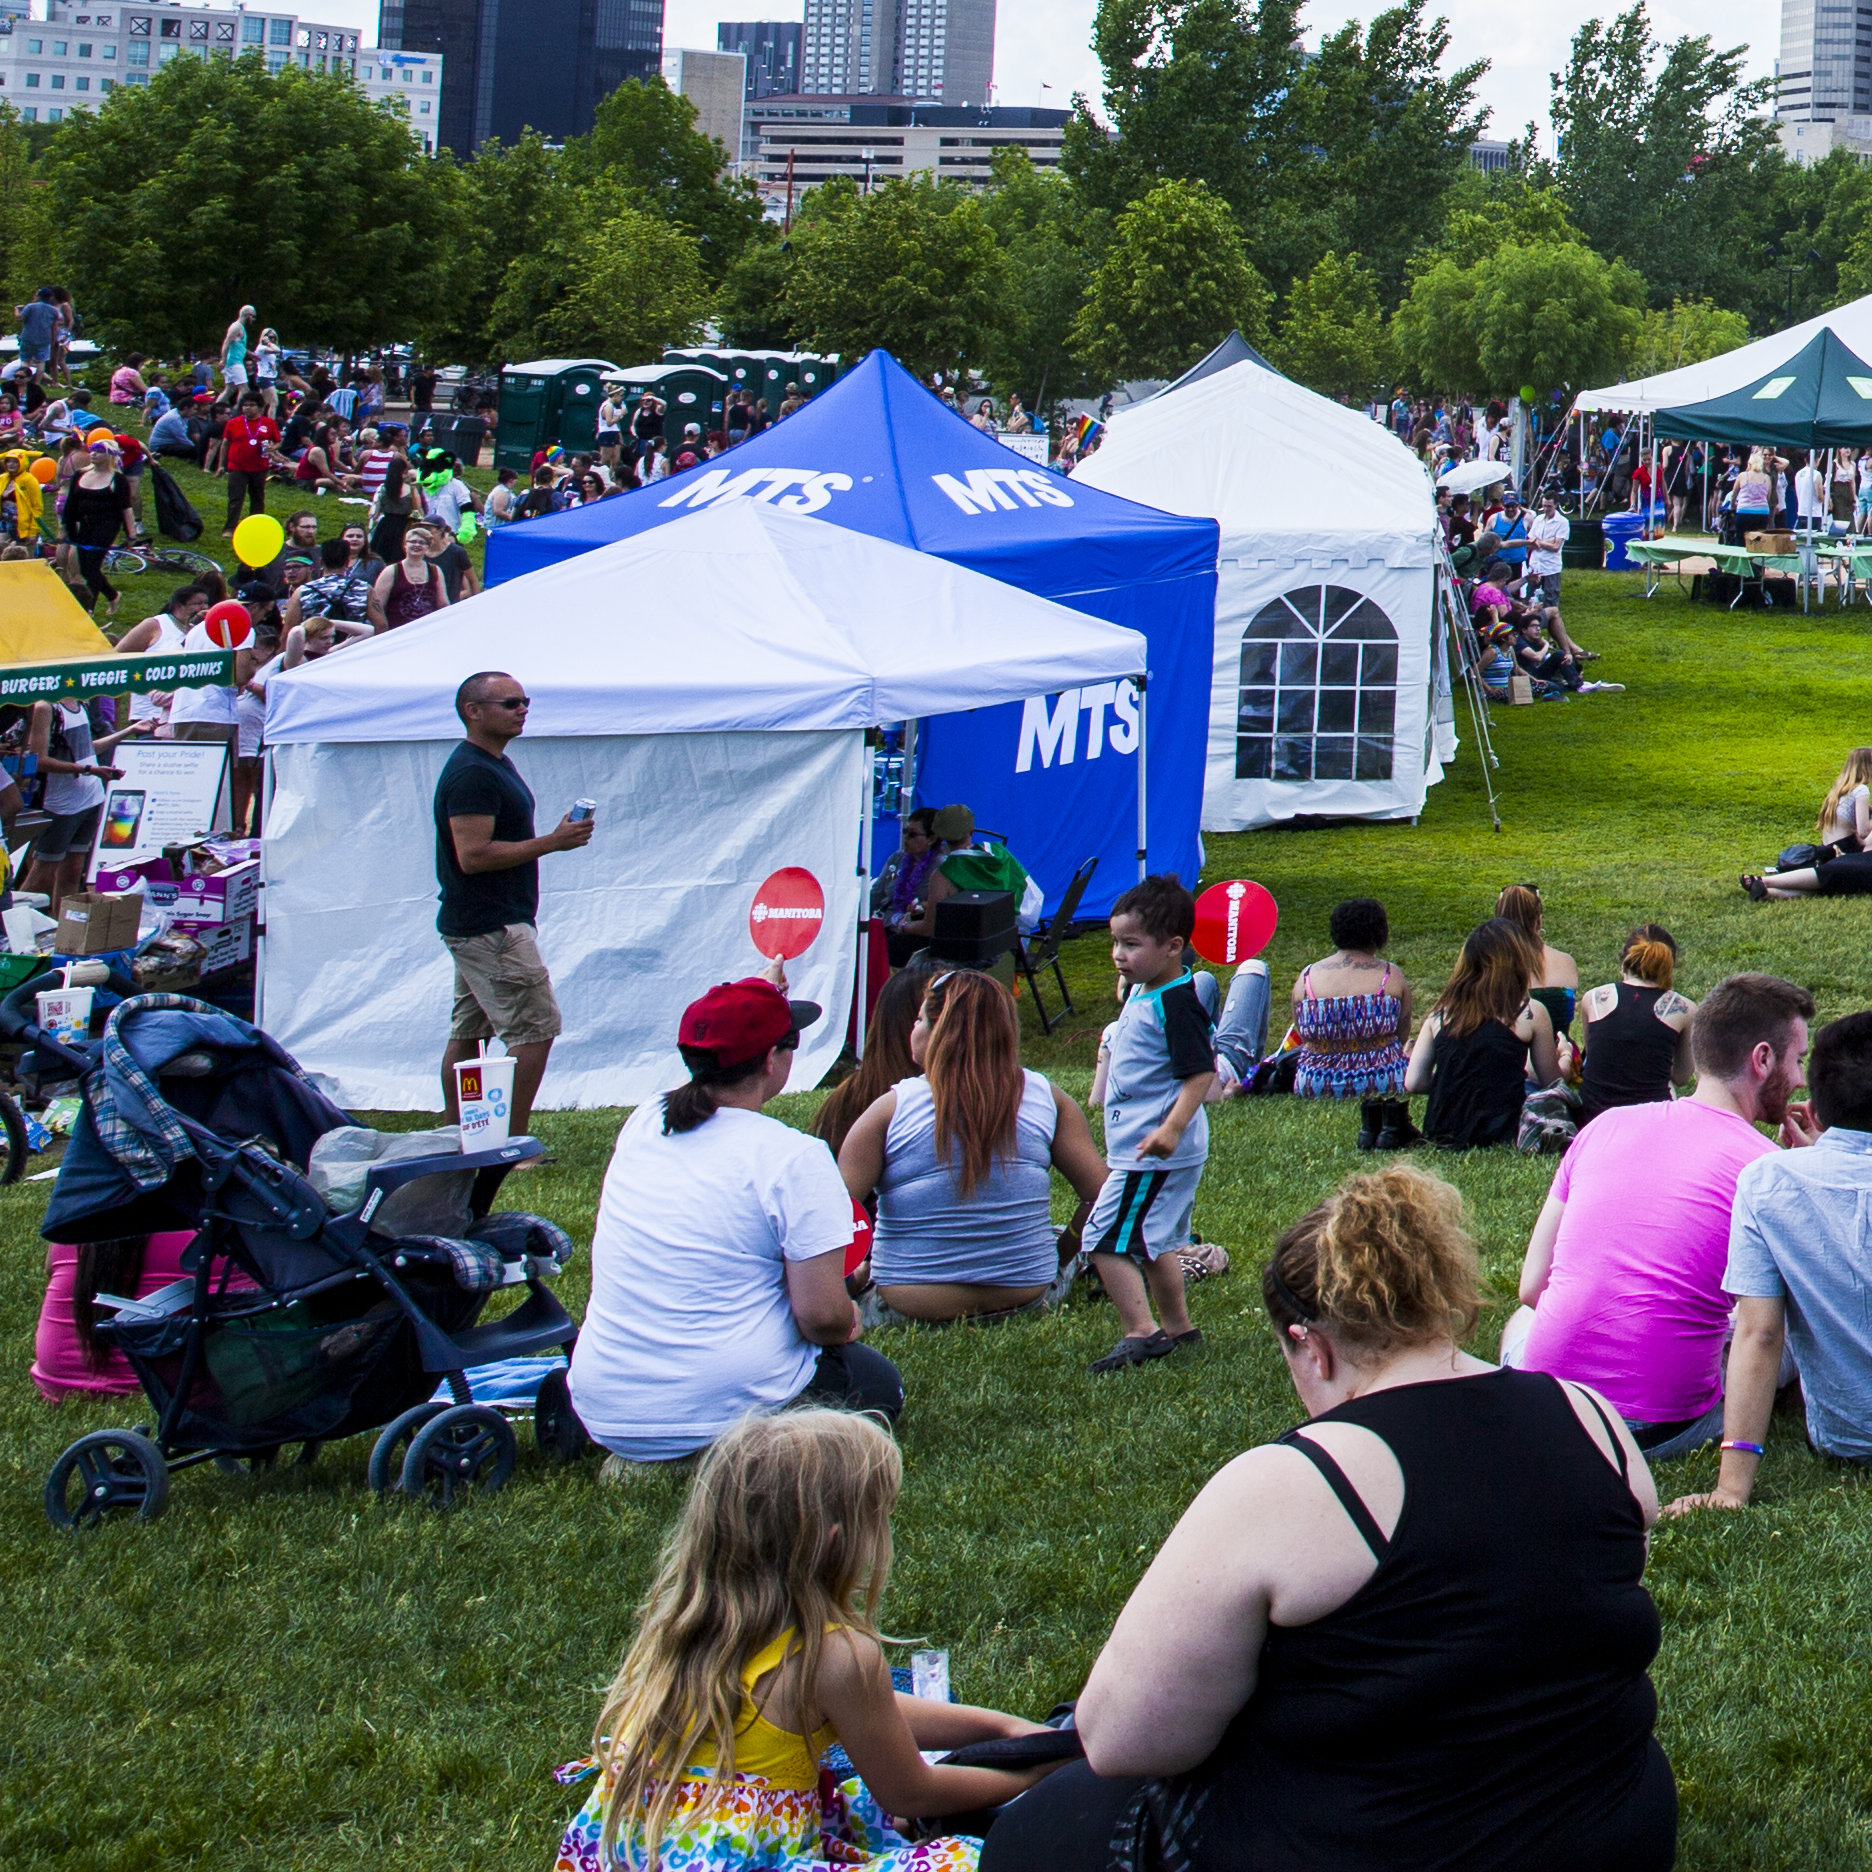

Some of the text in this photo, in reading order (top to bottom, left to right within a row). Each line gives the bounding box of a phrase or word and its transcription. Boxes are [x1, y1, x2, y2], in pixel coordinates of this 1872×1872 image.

[658, 468, 854, 514] MTS
[932, 469, 1075, 515] MTS
[1, 661, 223, 695] BURGERS VEGGIE COLD DRINKS
[1015, 678, 1139, 773] MTS
[137, 750, 156, 758] Post
[768, 908, 822, 918] MANITOBA
[1226, 900, 1240, 963] MANITOBA
